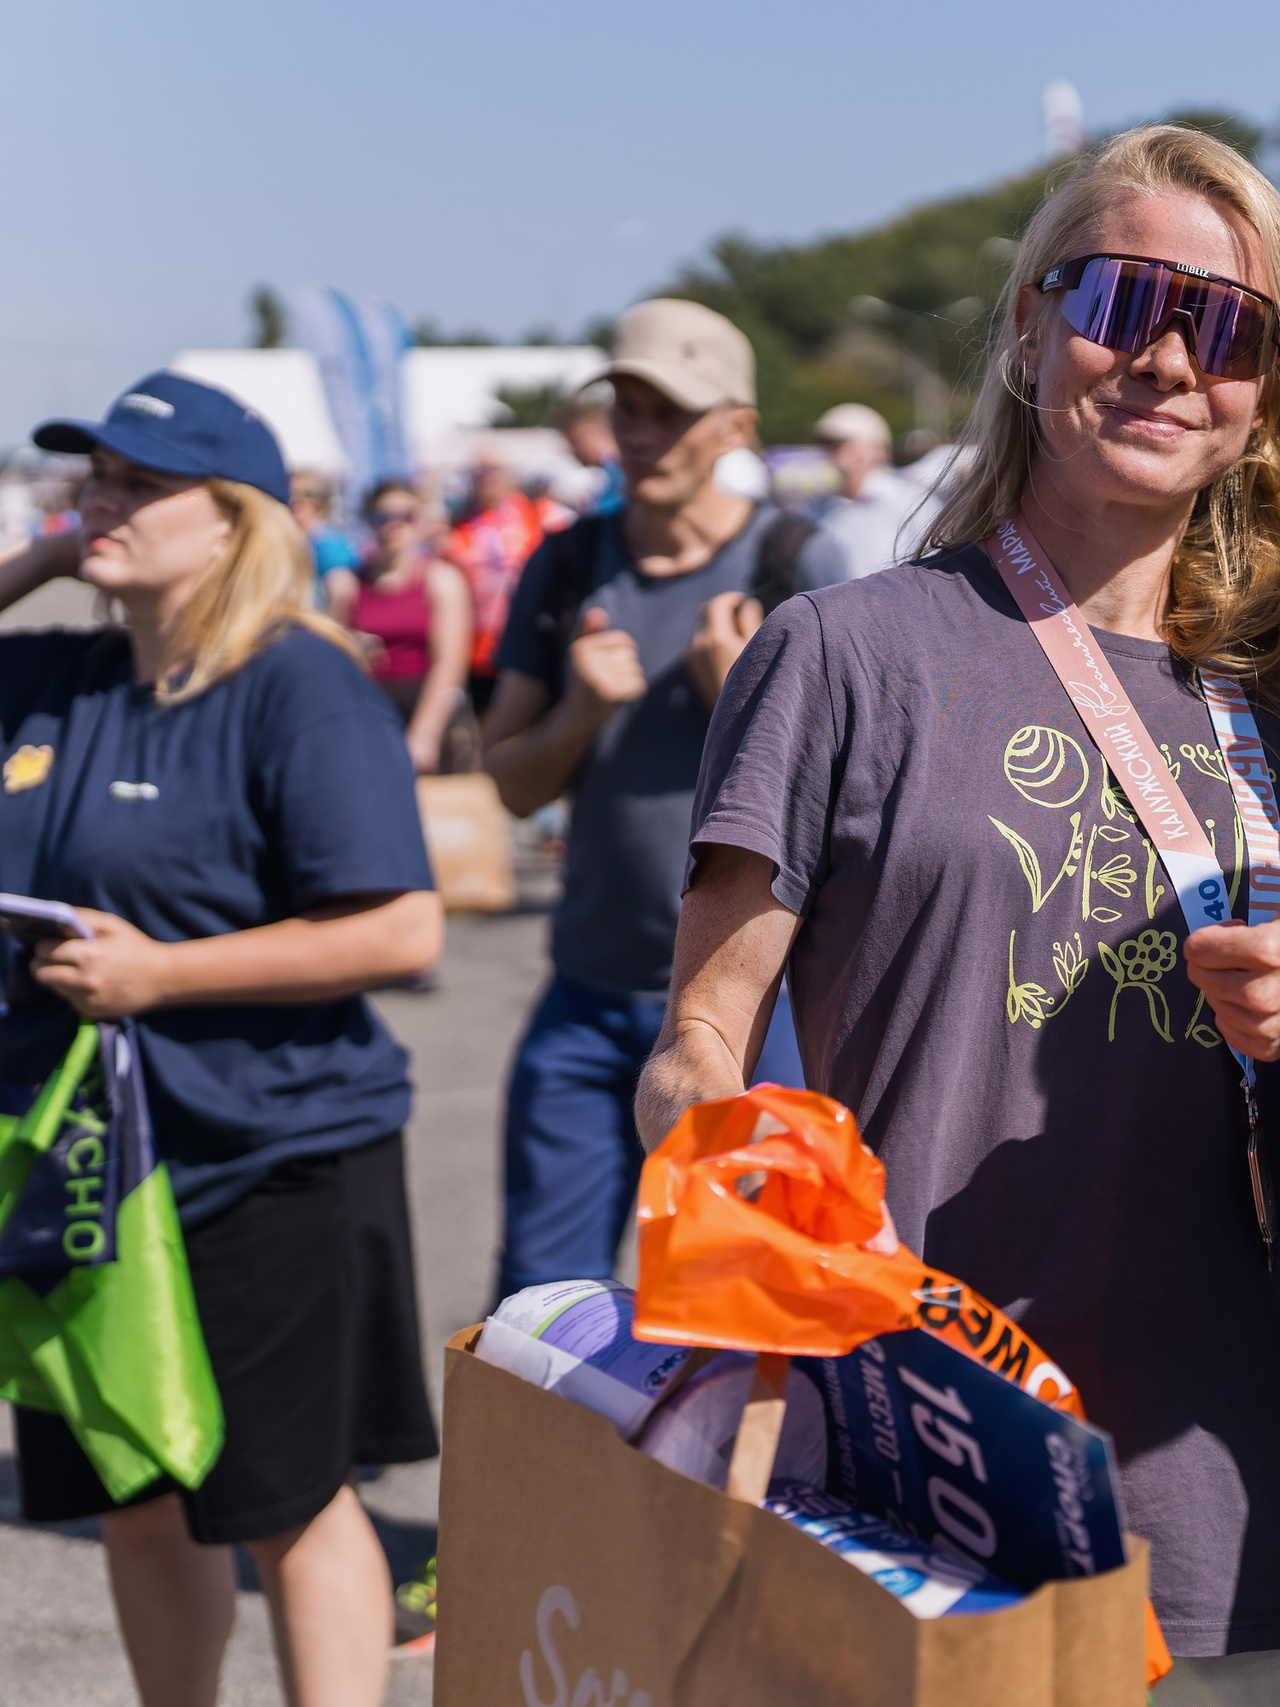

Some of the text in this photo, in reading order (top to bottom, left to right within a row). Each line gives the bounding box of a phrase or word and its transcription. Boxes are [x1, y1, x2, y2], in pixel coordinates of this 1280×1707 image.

[1189, 264, 1209, 278] BLIZ
[996, 519, 1037, 575] МАРАФ
[1104, 722, 1189, 841] КАЛУЖСКИЙ
[1199, 879, 1226, 922] 40
[62, 1108, 107, 1261] УСНО
[860, 1359, 900, 1463] МЕСТО
[898, 1366, 988, 1484] 15
[928, 1476, 997, 1560] 0
